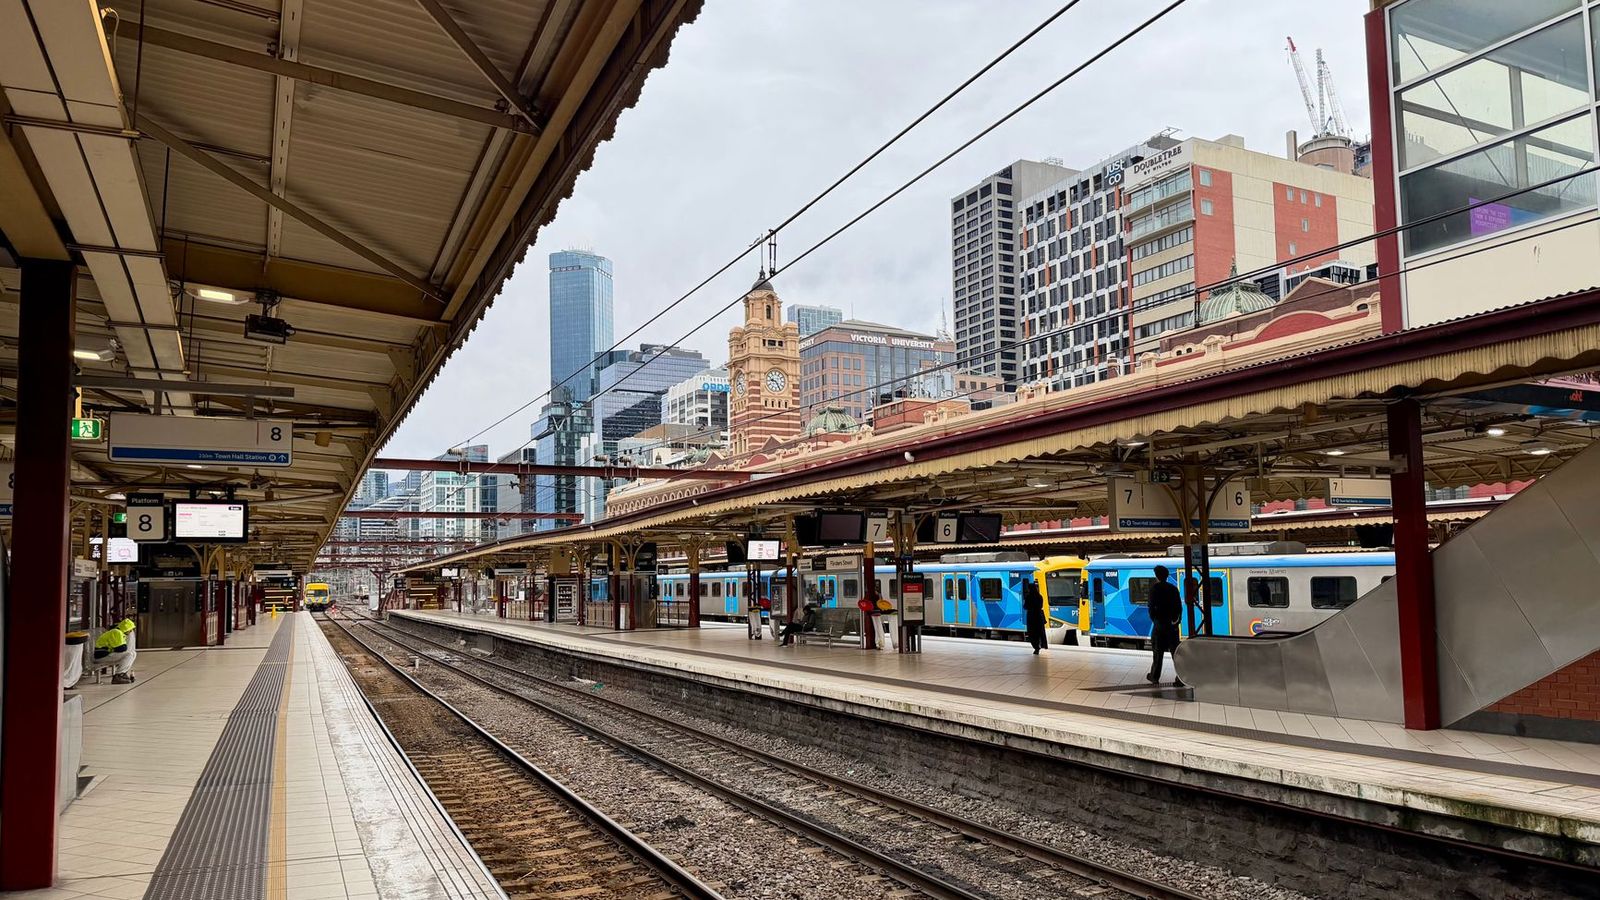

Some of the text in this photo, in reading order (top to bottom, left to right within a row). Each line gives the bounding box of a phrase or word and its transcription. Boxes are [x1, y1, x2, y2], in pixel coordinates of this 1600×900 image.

[850, 333, 935, 349] VICTORIA UNIVERSITY
[270, 426, 281, 442] 8
[232, 453, 244, 461] Hall
[245, 454, 267, 462] Station
[1333, 482, 1338, 491] 7
[1125, 489, 1133, 505] 7
[1235, 491, 1243, 506] 6
[138, 514, 152, 532] 8
[873, 524, 881, 537] 7
[942, 524, 950, 537] 6
